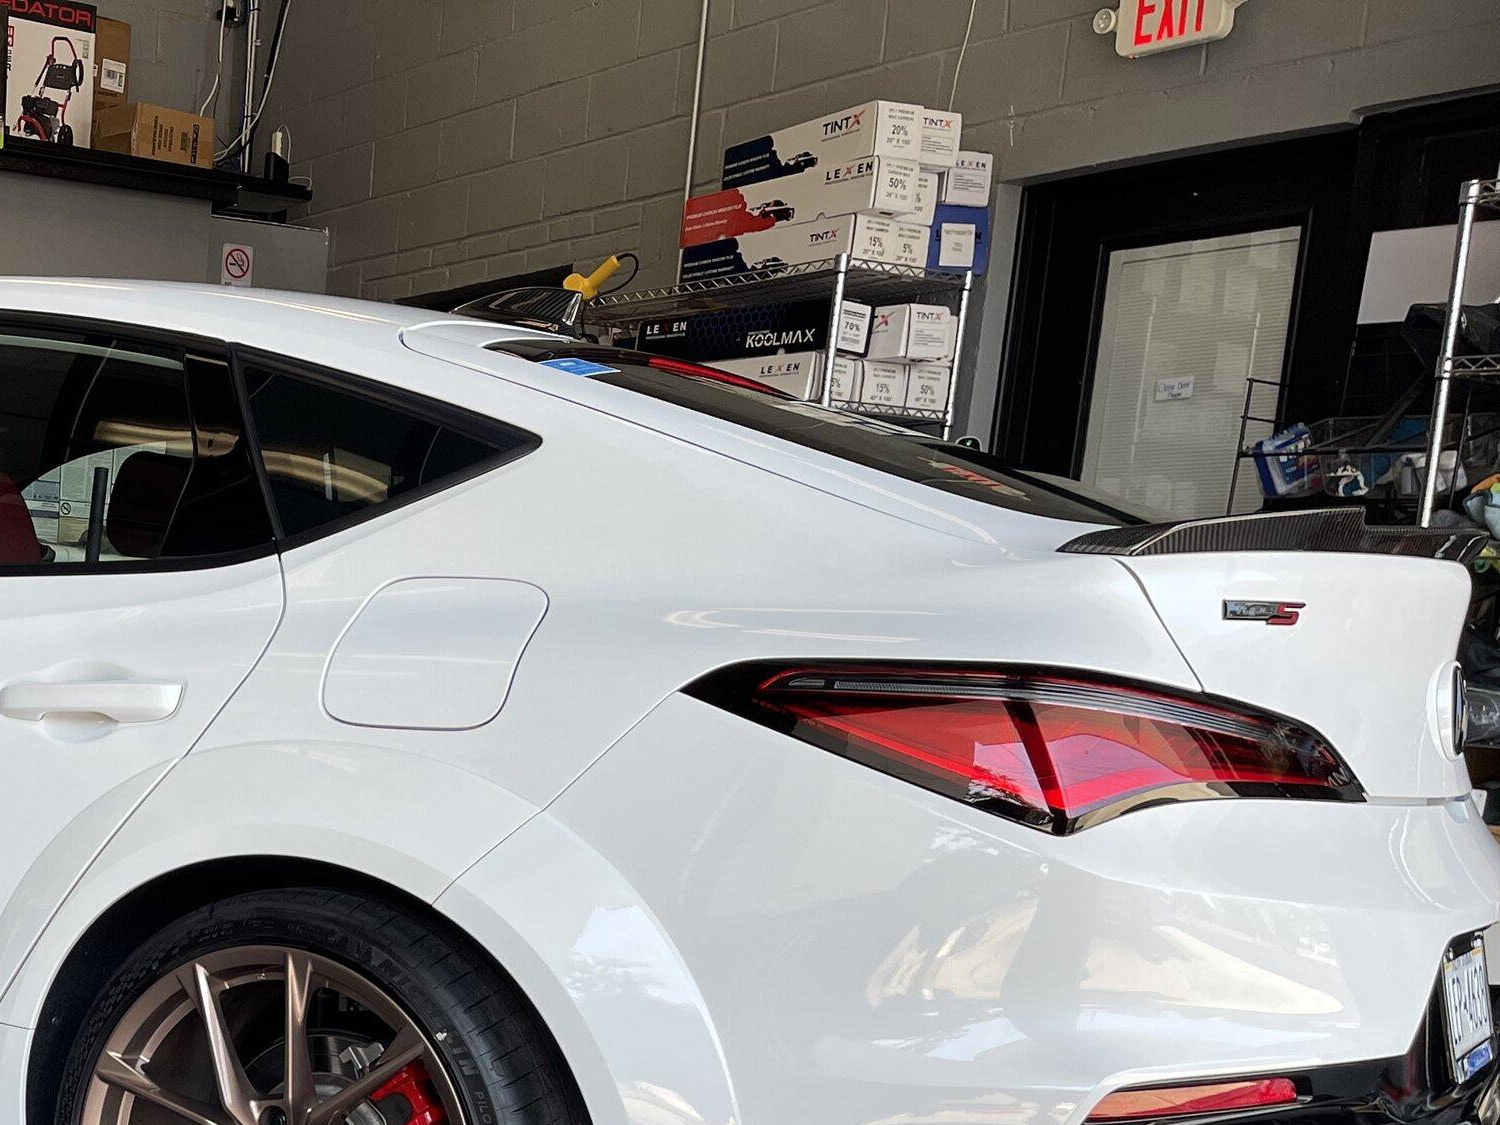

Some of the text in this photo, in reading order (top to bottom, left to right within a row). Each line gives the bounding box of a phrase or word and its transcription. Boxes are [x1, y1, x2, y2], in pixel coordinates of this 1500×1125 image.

[823, 108, 868, 136] TINTX
[923, 116, 954, 128] TINTX
[891, 124, 908, 136] 20%
[826, 161, 874, 181] LEXEN
[955, 161, 987, 169] LEXEN
[888, 177, 906, 190] 50%
[809, 228, 840, 243] TINTX
[869, 236, 883, 248] 15%
[902, 243, 913, 254] 5%
[917, 311, 944, 321] TINTX
[646, 321, 687, 335] LEXEN
[844, 321, 860, 332] 70%
[745, 328, 816, 349] KOOLMAX
[760, 363, 800, 375] LEXEN
[875, 382, 890, 394] 15%
[920, 384, 935, 396] 50%
